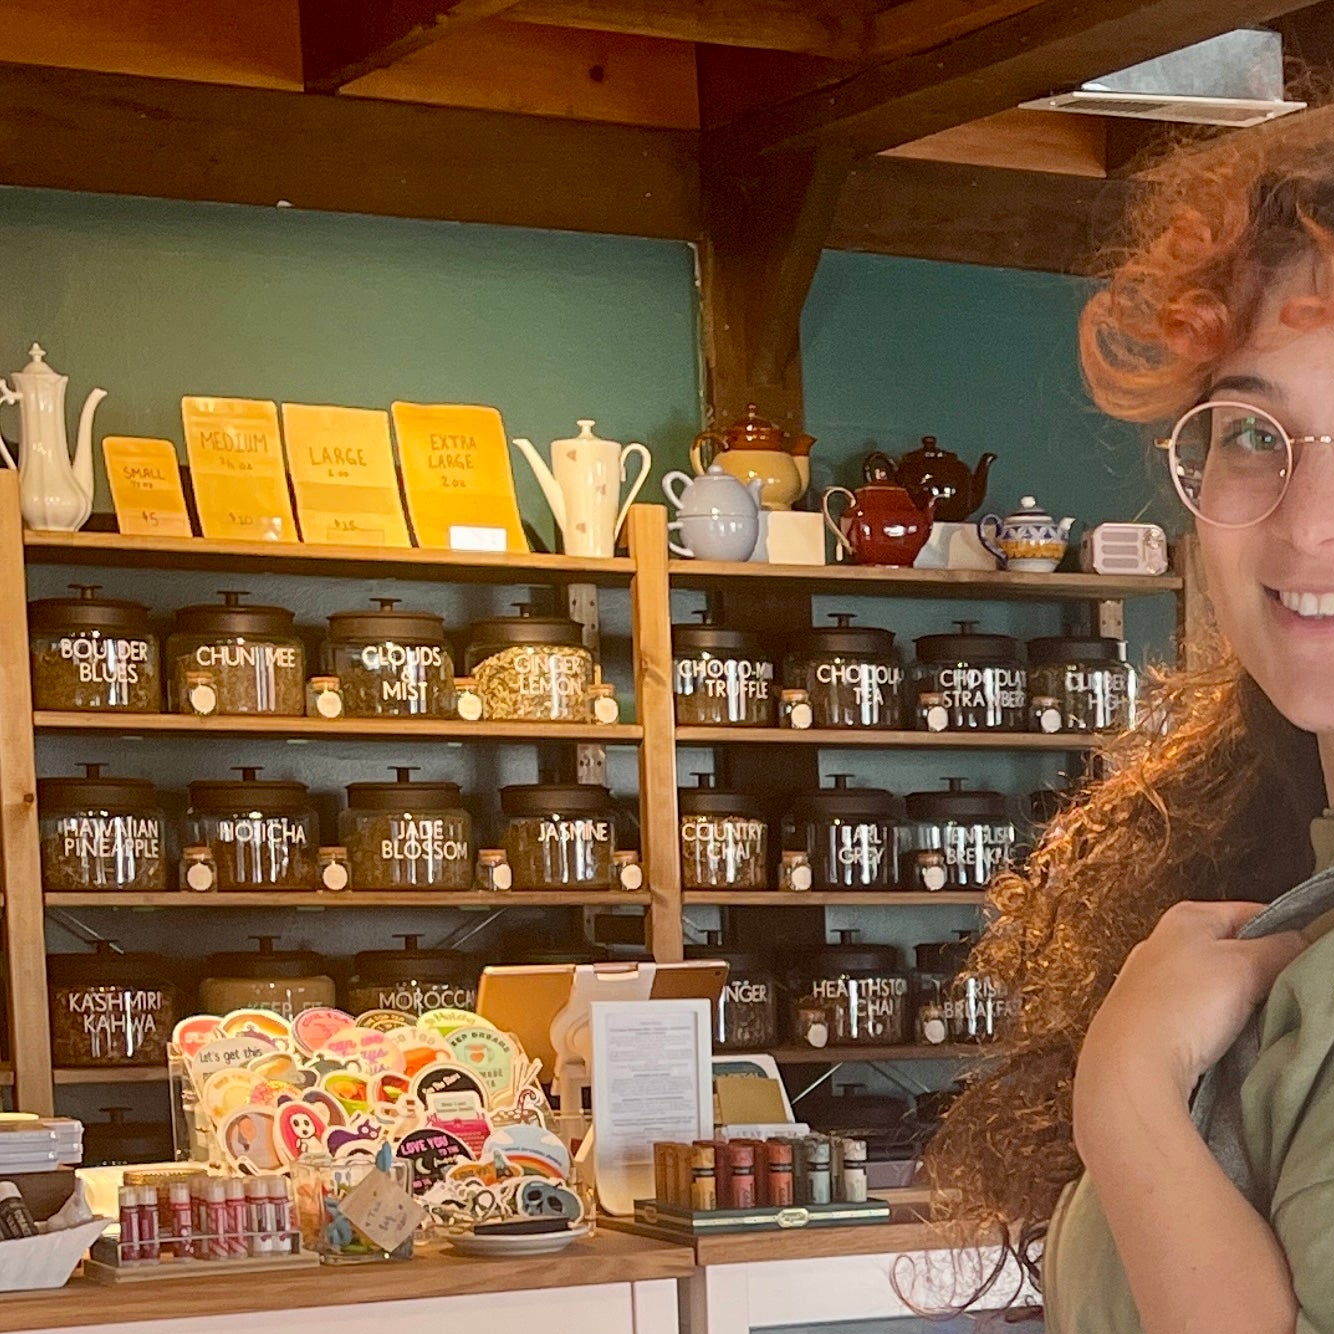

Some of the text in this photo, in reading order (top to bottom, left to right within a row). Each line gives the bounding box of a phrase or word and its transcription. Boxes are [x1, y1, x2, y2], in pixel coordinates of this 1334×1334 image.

[200, 432, 268, 453] MEDIUM
[430, 433, 477, 450] EXTRA
[309, 447, 367, 467] LARGE
[428, 454, 474, 470] LARGE
[123, 466, 166, 481] SMALL
[60, 638, 148, 661] BOULDER
[197, 646, 256, 667] CHUN
[361, 646, 442, 667] CLOUDS
[79, 663, 138, 684] BLUES
[514, 655, 582, 674] GINGER
[383, 681, 428, 701] MIST
[519, 676, 582, 695] LEMON
[397, 821, 443, 840] JADE
[538, 822, 608, 841] JASMINE
[682, 823, 764, 842] COUNTRY
[64, 838, 158, 858] PINEAPPLE
[382, 841, 467, 860] BLOSSOM
[69, 990, 162, 1012] KASHMIRI
[725, 984, 767, 1003] NGER
[84, 1014, 156, 1033] KAHWA
[223, 1050, 240, 1064] get
[400, 1134, 449, 1156] LOVE YOU
